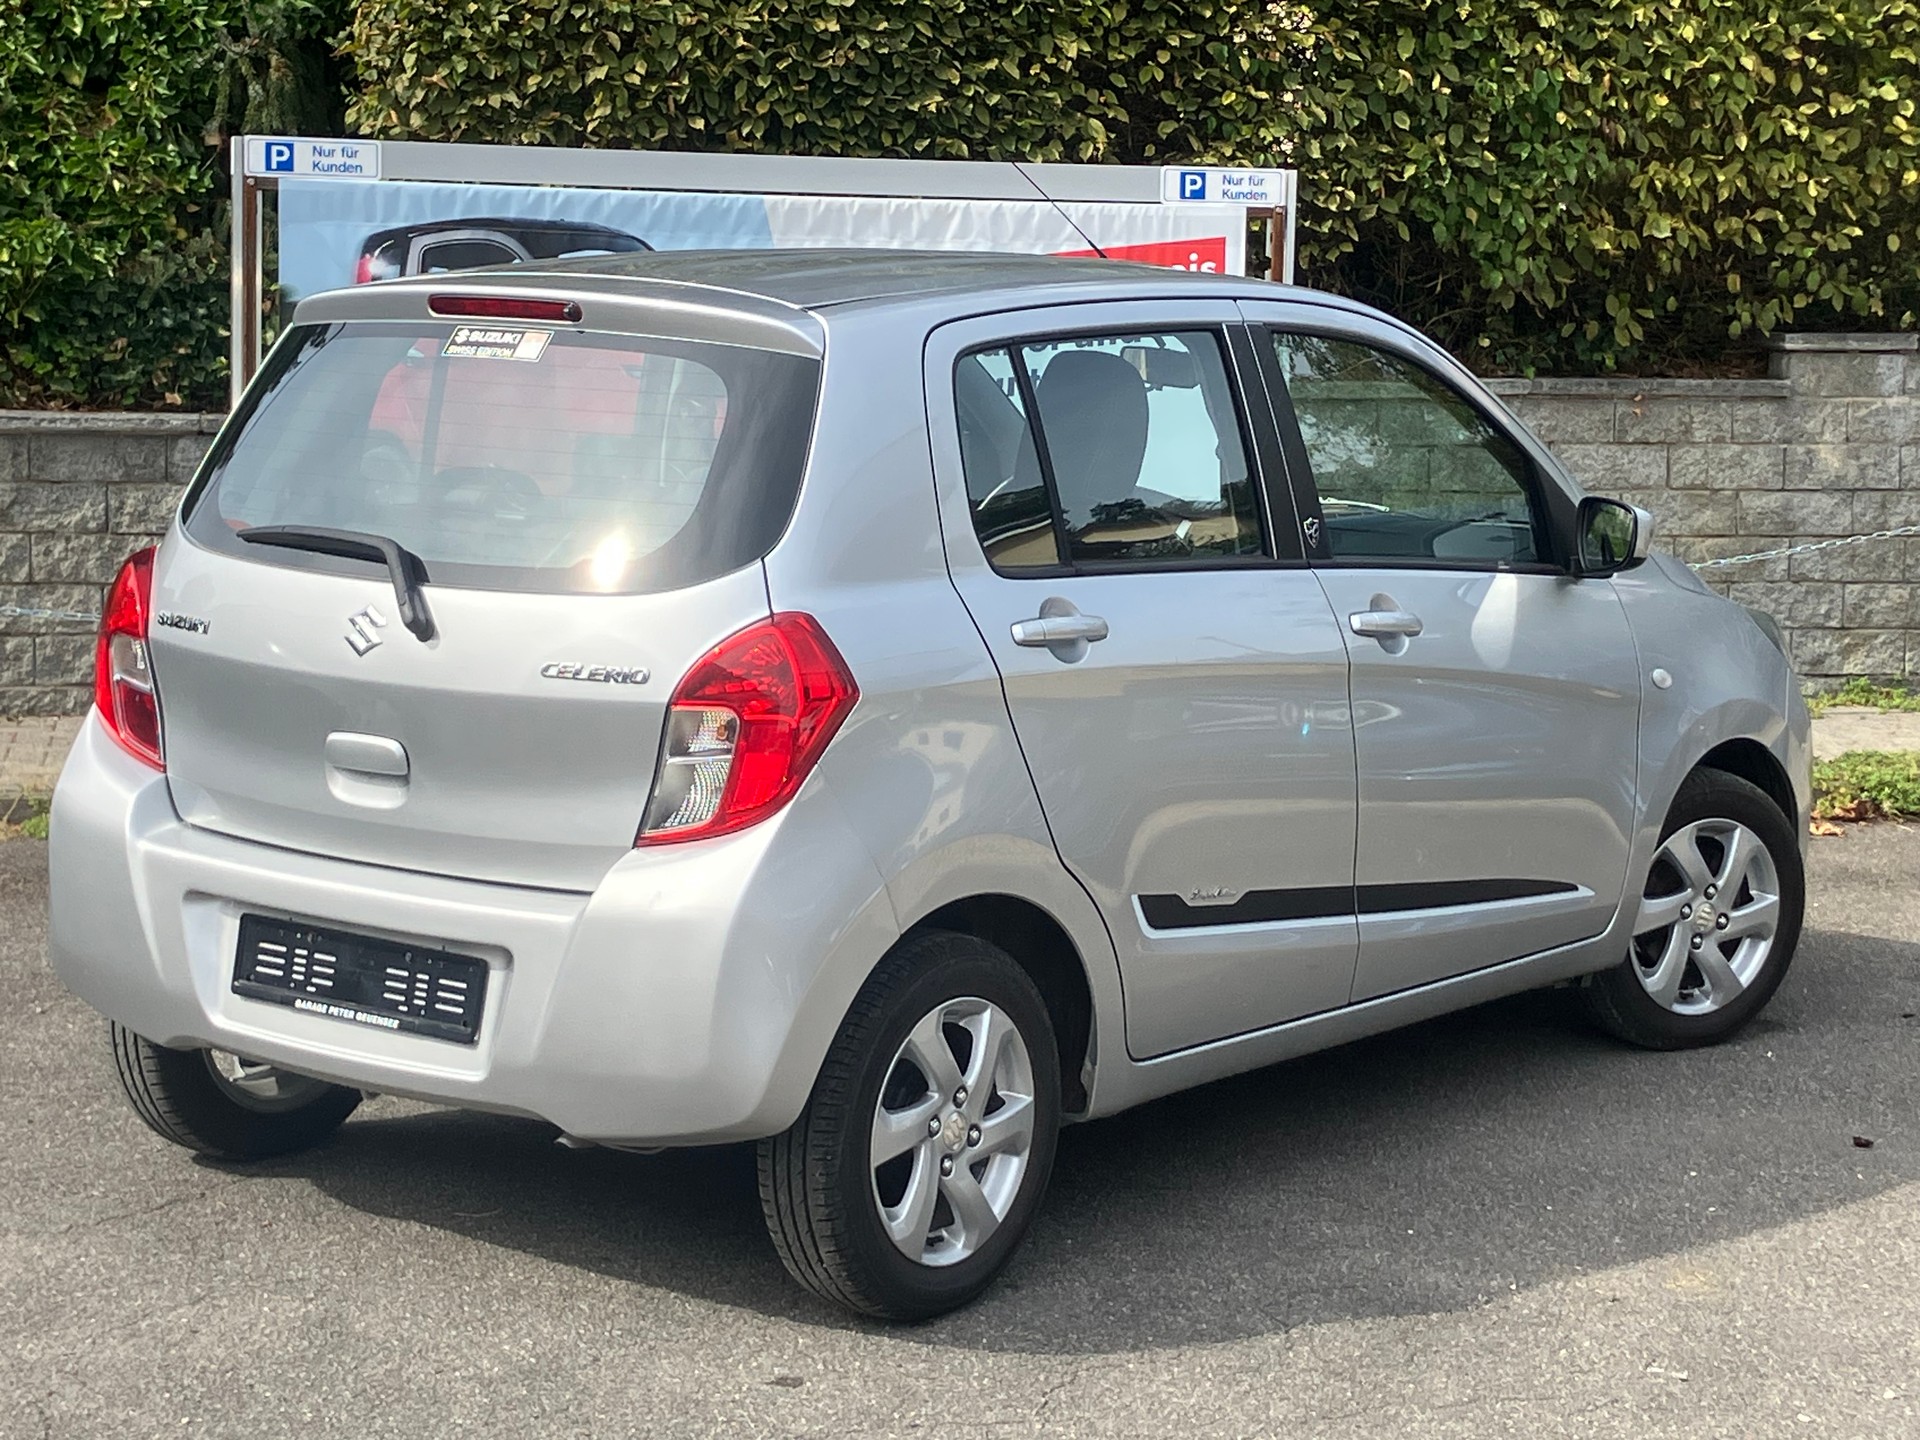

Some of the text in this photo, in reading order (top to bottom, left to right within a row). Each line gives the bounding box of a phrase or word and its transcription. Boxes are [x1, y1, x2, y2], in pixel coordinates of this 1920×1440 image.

[271, 145, 290, 170] P
[312, 145, 359, 159] Nur für
[312, 160, 363, 173] Kunden
[1184, 174, 1203, 198] P
[1222, 174, 1265, 187] Nur für
[1222, 188, 1268, 201] Kunden
[468, 330, 522, 344] SUZUKI
[477, 346, 514, 358] EDITION
[157, 612, 211, 635] SUZUKI
[541, 661, 651, 685] CELERIO
[294, 998, 328, 1014] GARAGE
[328, 1005, 355, 1019] PETER
